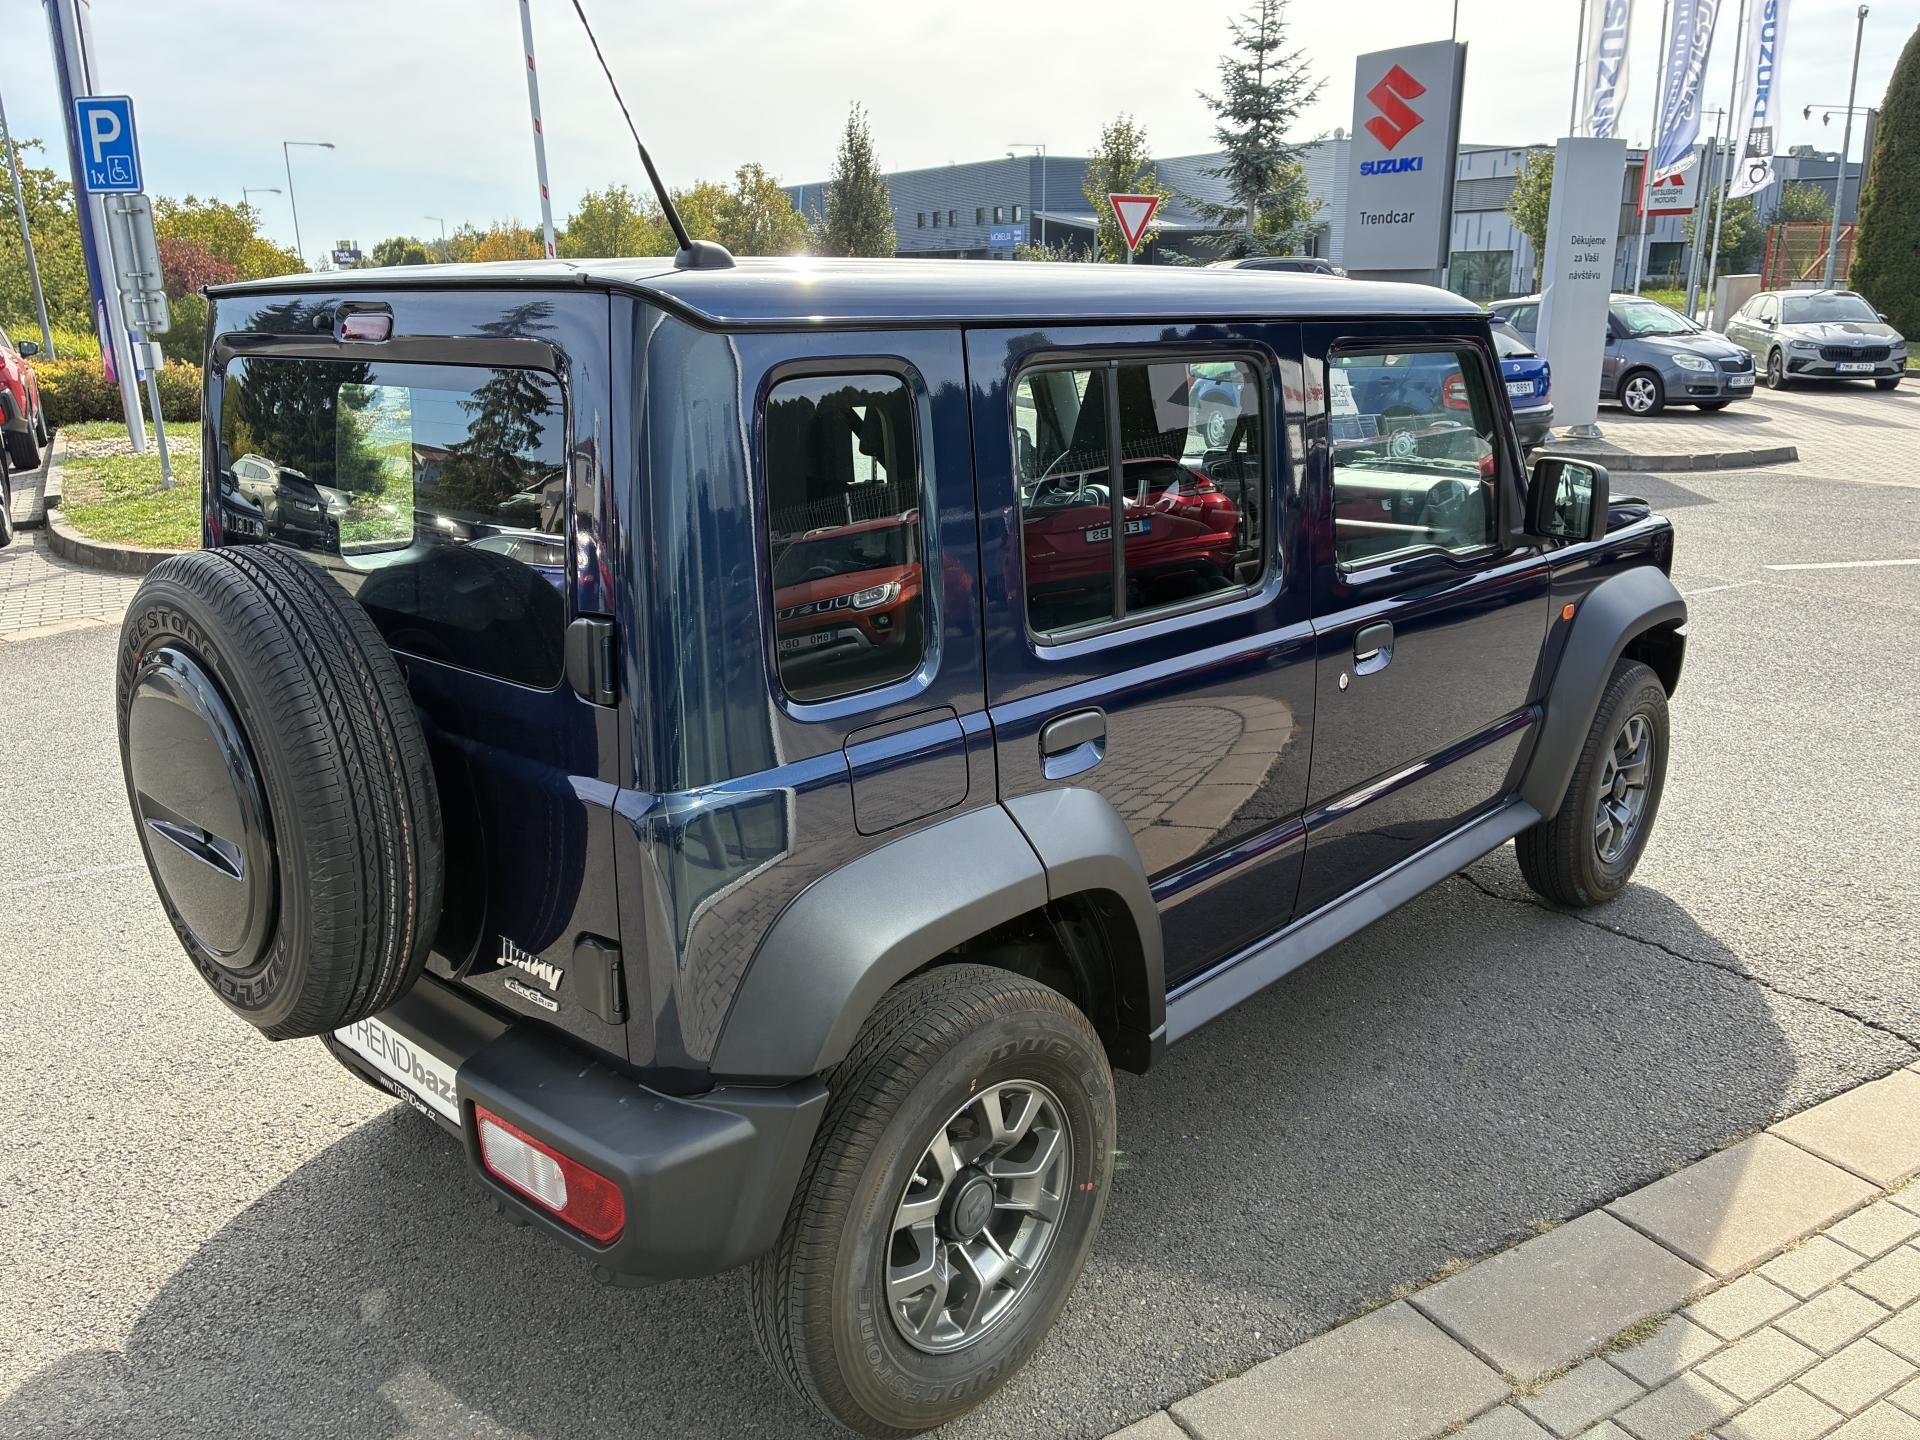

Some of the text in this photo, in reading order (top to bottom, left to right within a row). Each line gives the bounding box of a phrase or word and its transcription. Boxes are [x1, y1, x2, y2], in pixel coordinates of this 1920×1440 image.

[1753, 0, 1778, 118] SUZUKI
[88, 109, 121, 163] P
[1360, 156, 1424, 176] SUZUKI
[91, 169, 106, 185] 1x
[1360, 209, 1415, 225] Trendcar
[1571, 235, 1607, 247] Děkujeme
[1574, 255, 1583, 263] za
[1568, 270, 1601, 280] návštěvu
